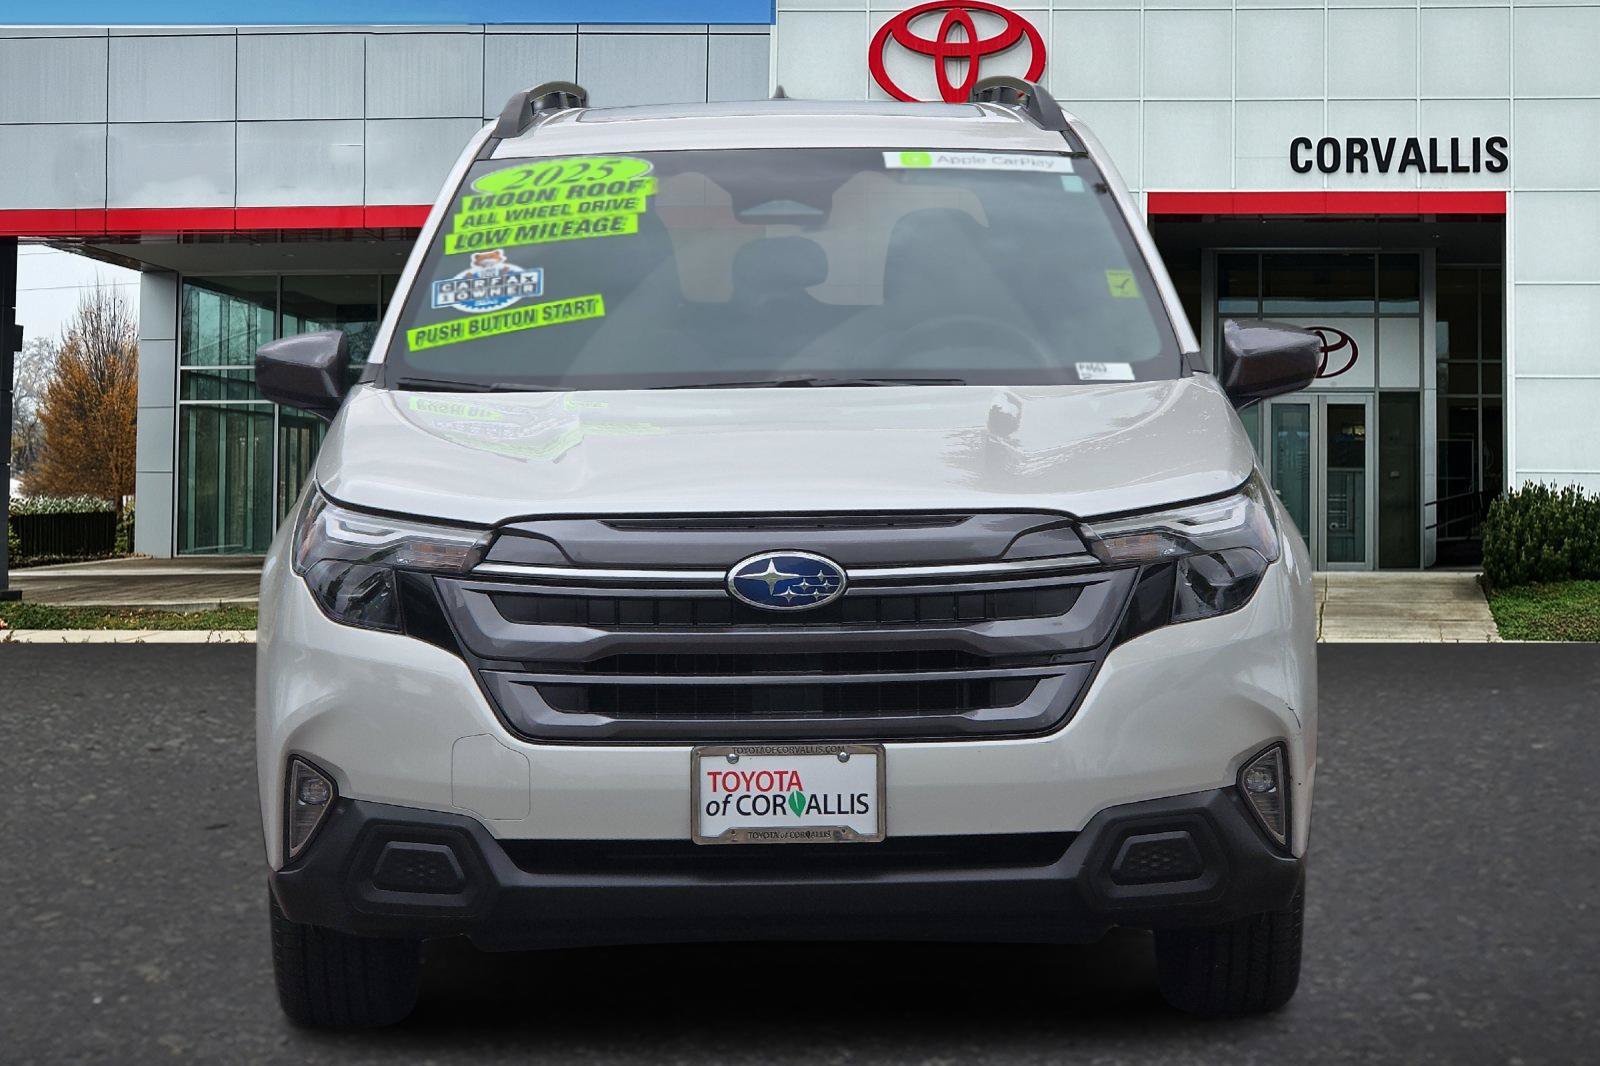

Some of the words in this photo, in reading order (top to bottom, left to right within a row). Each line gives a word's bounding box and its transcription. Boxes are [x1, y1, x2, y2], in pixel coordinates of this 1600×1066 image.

[937, 154, 986, 167] Apple
[991, 156, 1056, 170] CarPlay
[1290, 136, 1509, 174] CORVALLIS
[502, 159, 622, 191] 2025
[468, 187, 556, 211] MOON
[565, 178, 646, 200] ROOF
[461, 211, 497, 228] ALL
[505, 203, 572, 222] WHEEL
[578, 196, 638, 214] DRIVE
[454, 229, 510, 250] LOW
[514, 215, 627, 241] MILEAGE
[440, 274, 535, 293] CARFAX
[456, 284, 535, 301] OWNER
[415, 322, 462, 347] PUSH
[468, 310, 537, 335] BUTTON
[542, 298, 599, 321] START
[706, 770, 804, 793] TOYOTA
[705, 793, 733, 817] of
[748, 831, 779, 840] TOYOTA
